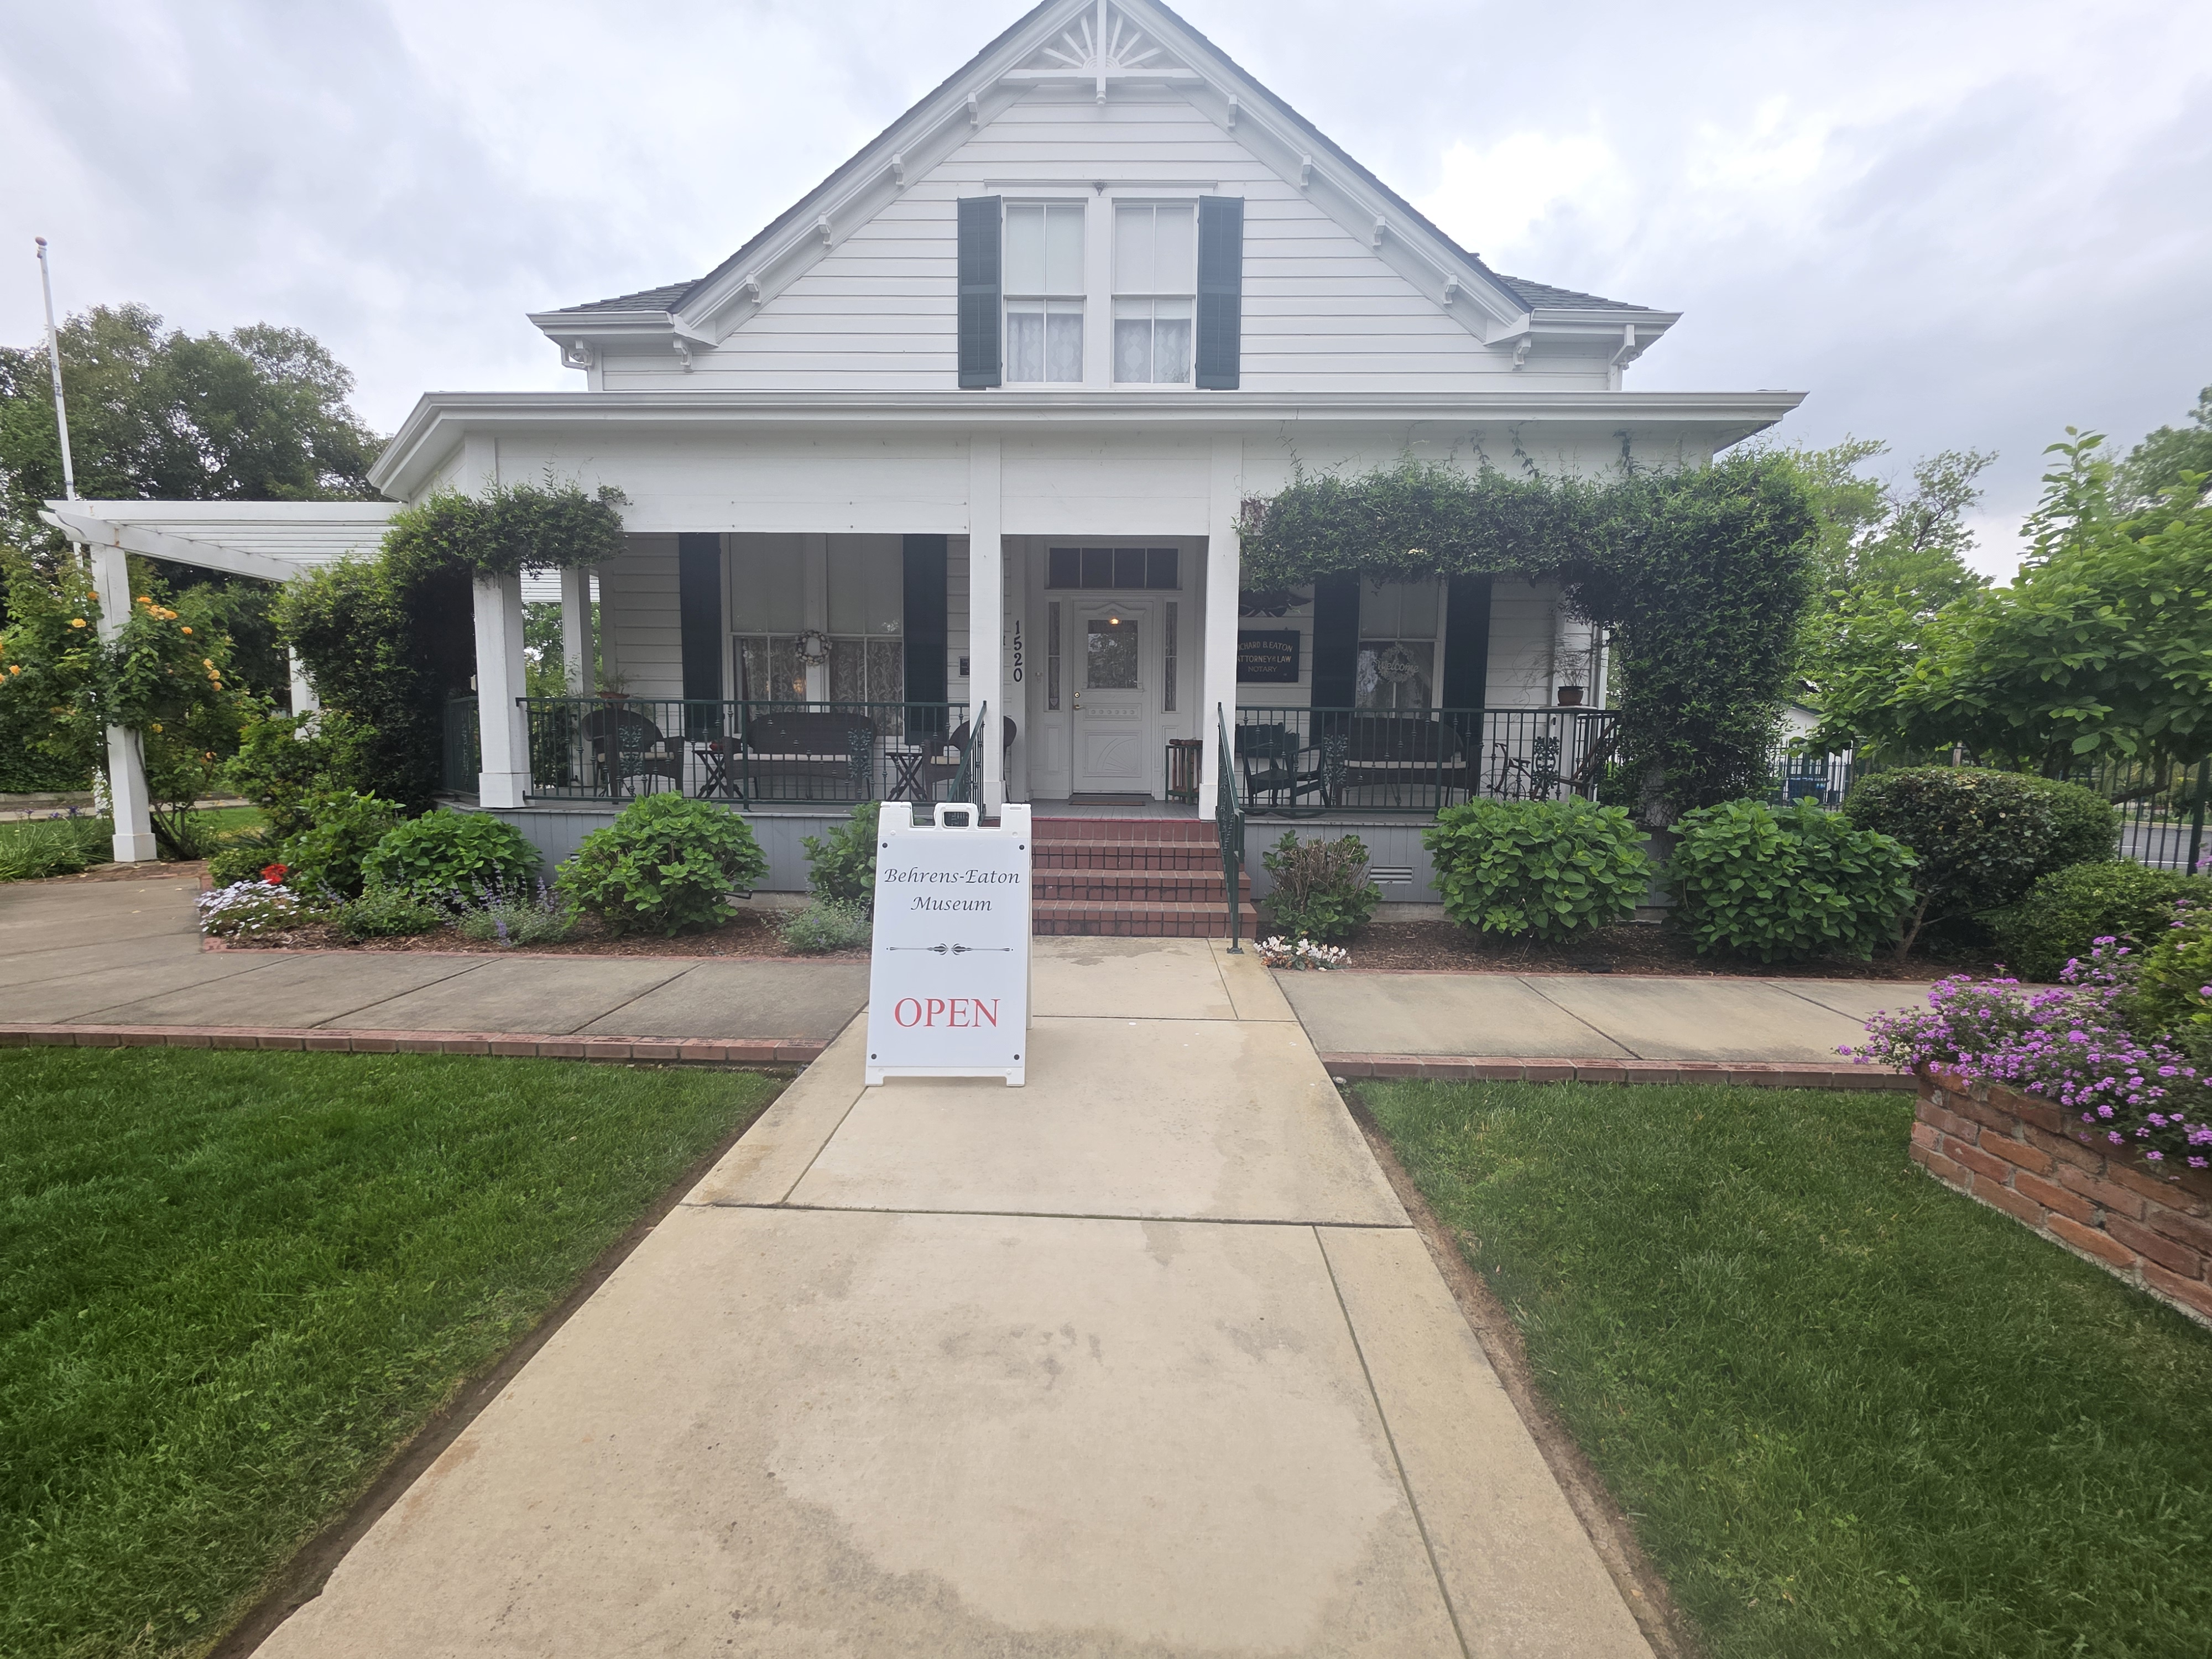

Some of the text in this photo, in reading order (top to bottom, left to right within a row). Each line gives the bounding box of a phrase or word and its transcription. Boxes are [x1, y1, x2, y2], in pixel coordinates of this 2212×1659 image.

[1013, 620, 1022, 682] 1520
[1238, 641, 1260, 650] ICHARD
[1269, 641, 1292, 652] EATON
[884, 867, 1020, 884] Behrens-Eaton
[910, 896, 992, 911] Museum
[894, 998, 1001, 1027] OPEN
